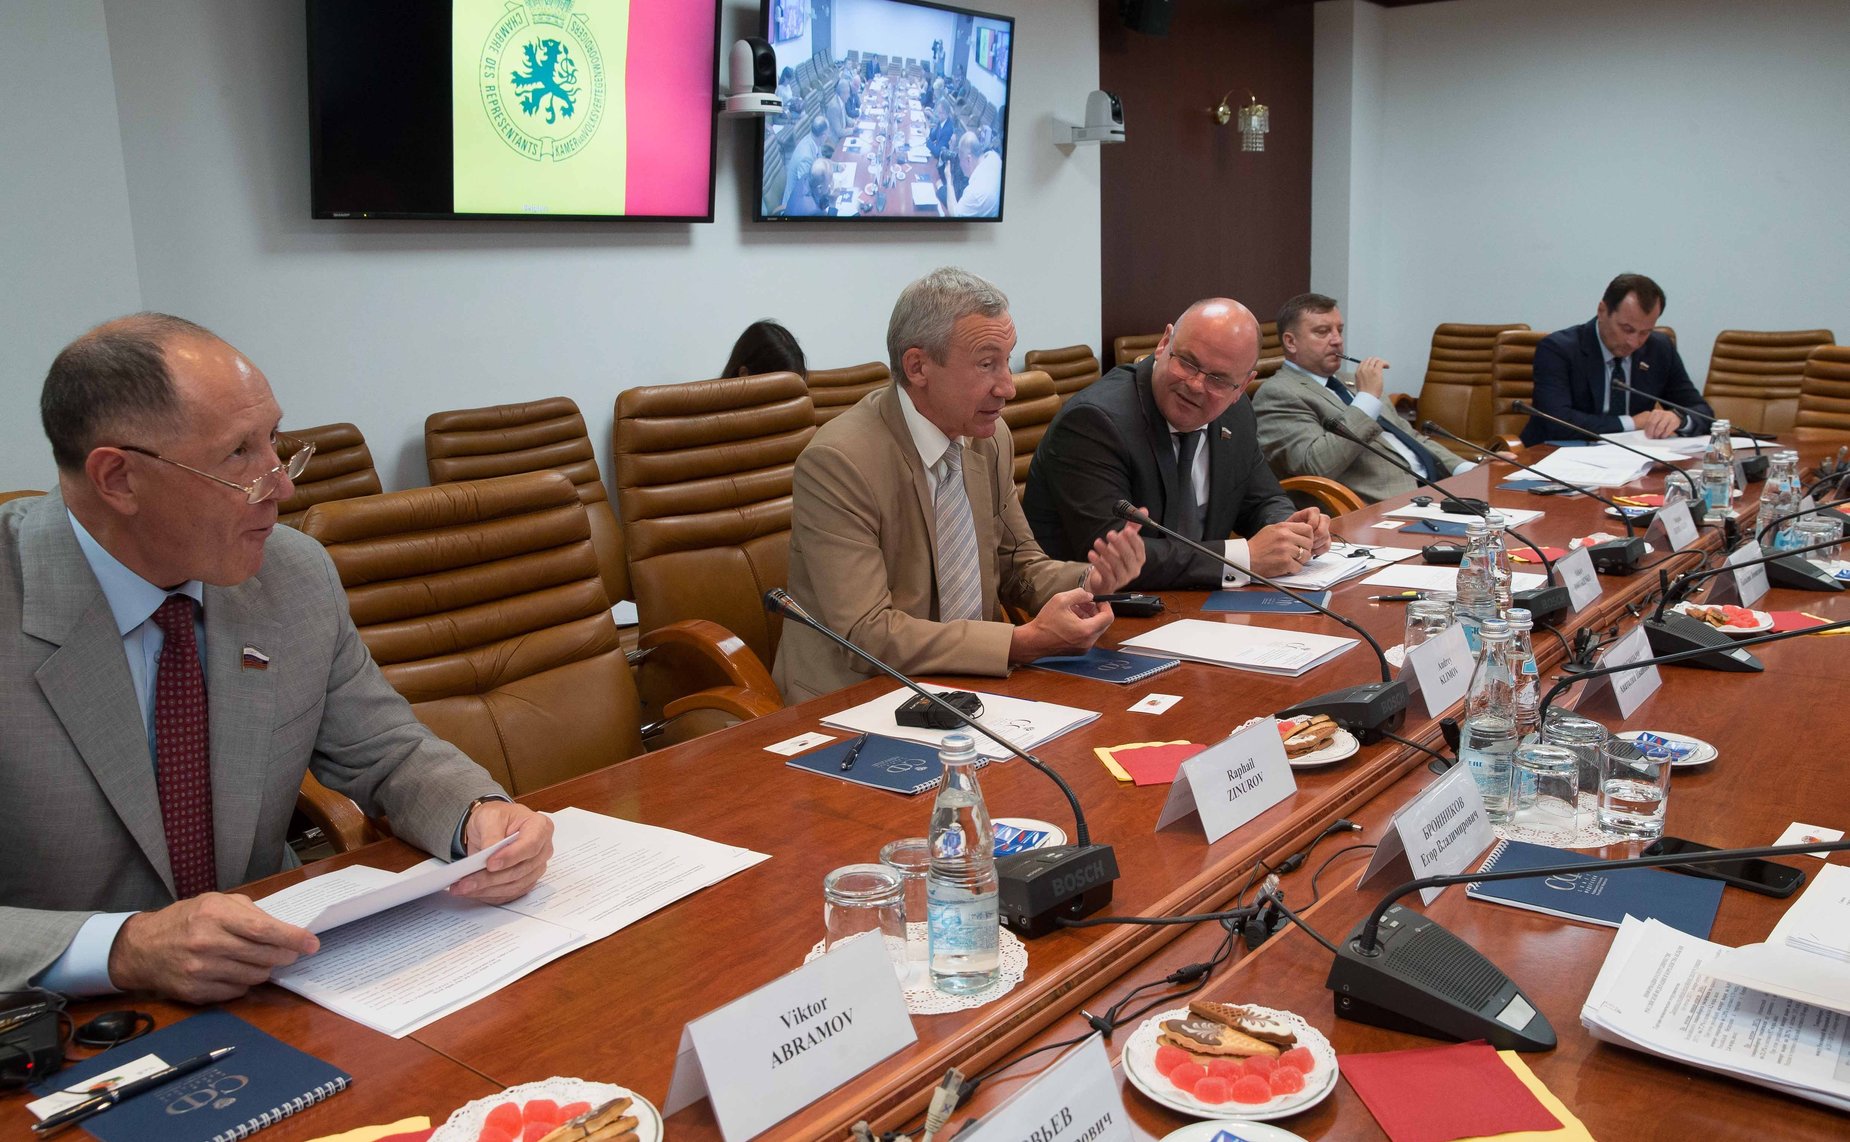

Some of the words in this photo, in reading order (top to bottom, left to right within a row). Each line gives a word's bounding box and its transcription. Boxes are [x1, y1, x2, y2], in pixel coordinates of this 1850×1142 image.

[489, 12, 523, 53] CHAMBRE
[484, 57, 496, 79] DES
[485, 85, 538, 156] REPRESENTANTS
[555, 137, 580, 157] KAMER
[1440, 666, 1459, 686] KLIMOV
[1226, 757, 1256, 782] Raphail
[1226, 771, 1264, 802] ZINUROV
[1422, 796, 1465, 841] БРОННИКОВ
[1420, 848, 1438, 868] Егор
[1436, 810, 1480, 853] Владимирович
[1052, 859, 1105, 898] BOSCH
[779, 997, 828, 1029] Viktor
[771, 1007, 853, 1070] ABRAMOV
[1020, 1106, 1073, 1142] ВЬЕВ
